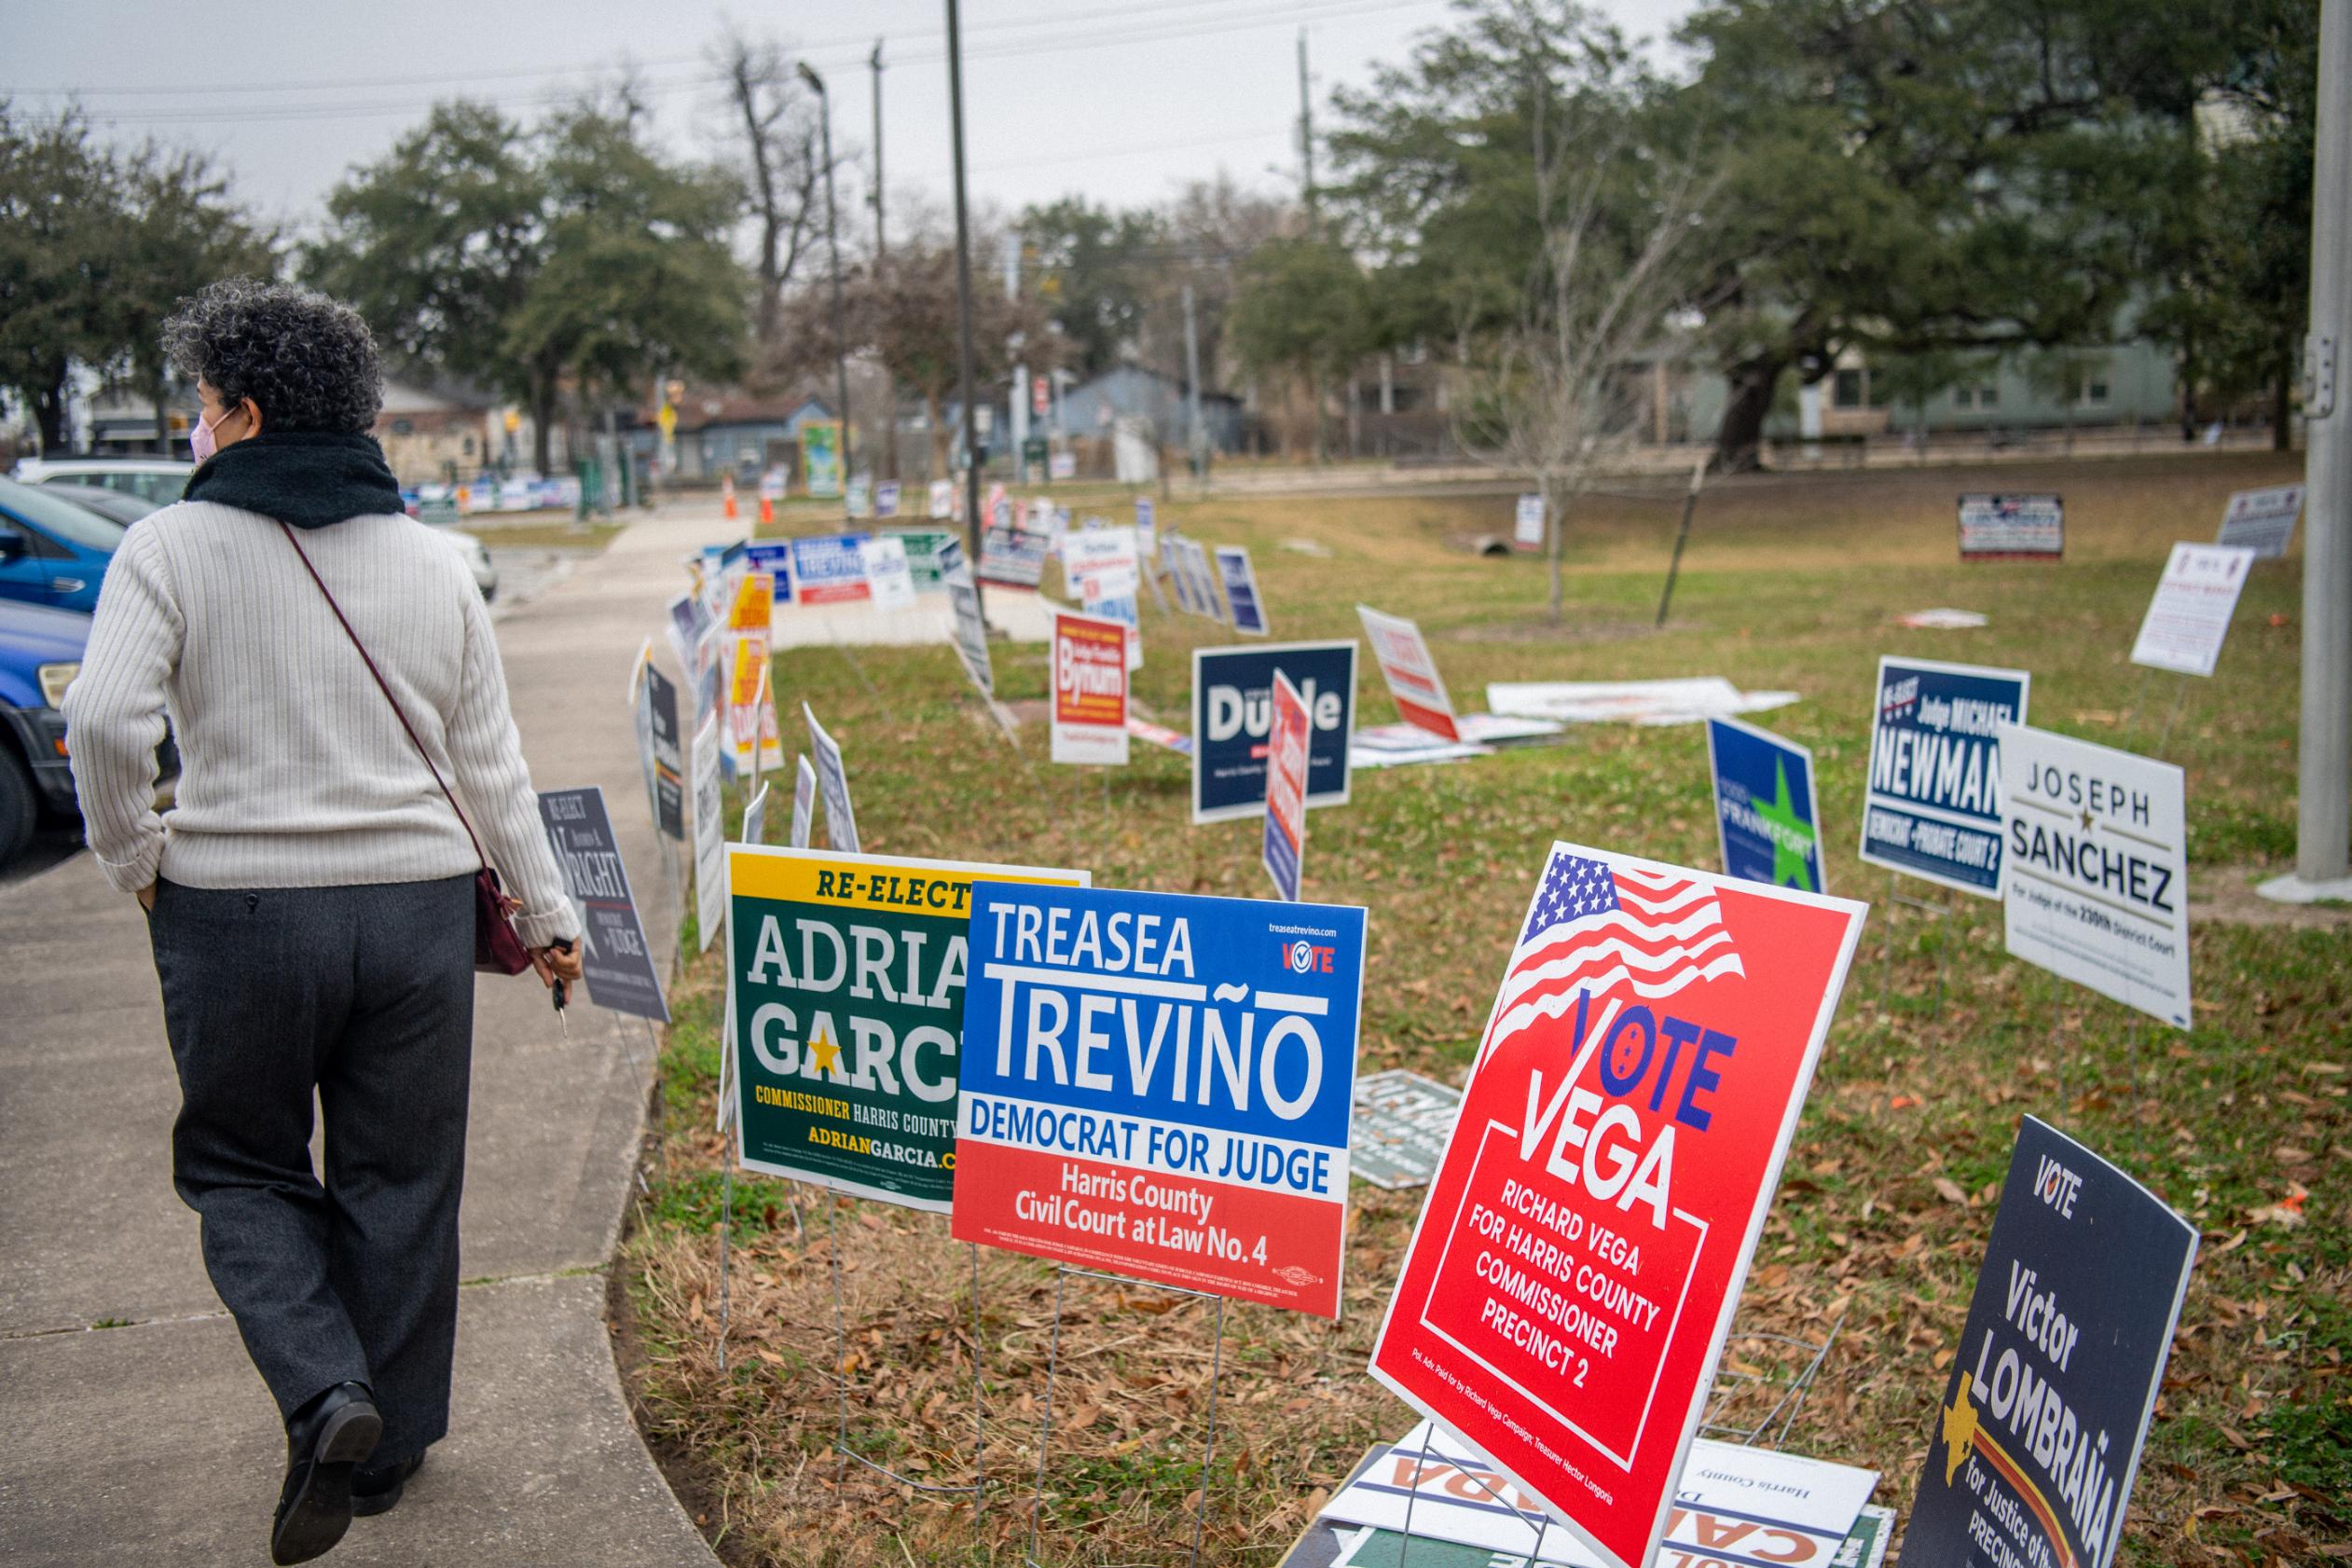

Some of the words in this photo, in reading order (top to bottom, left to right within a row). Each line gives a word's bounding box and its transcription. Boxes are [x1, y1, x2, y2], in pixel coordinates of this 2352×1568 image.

[1059, 636, 1122, 706] Bynum
[1207, 679, 1342, 741] Dule
[1874, 724, 2003, 817] NEWMAN
[2027, 763, 2150, 828] JOSEPH
[548, 826, 626, 898] WRIGHT
[1722, 797, 1813, 862] FRANKFORT
[1987, 838, 2000, 872] 2
[2011, 818, 2174, 914] SANCHEZ
[817, 870, 972, 910] RE-ELECT
[747, 915, 969, 1010] ADRIA
[988, 902, 1195, 978] TREASEA
[1269, 922, 1337, 938] treaseatrevino.com
[1282, 940, 1335, 974] VOTE
[2113, 921, 2146, 945] District
[2148, 931, 2175, 958] Court
[750, 1002, 964, 1103] GARC
[983, 962, 1329, 1121] TREVIÑO
[1571, 988, 1738, 1133] VOTE
[755, 1084, 850, 1121] COMMISSIONER
[853, 1103, 899, 1131] HARRIS
[902, 1113, 958, 1139] COUNTY
[808, 1126, 956, 1170] ADRIANGARCIA.C
[970, 1098, 1139, 1161] DEMOCRAT
[1148, 1126, 1210, 1174] FOR
[1218, 1138, 1330, 1194] JUDGE
[1520, 997, 1675, 1231] VEGA
[1062, 1162, 1126, 1202] Harris
[1130, 1176, 1213, 1225] County
[2033, 1154, 2083, 1220] VOTE
[1015, 1190, 1061, 1226] Civil
[1064, 1201, 1125, 1239] Court
[1133, 1217, 1155, 1242] at
[1158, 1217, 1204, 1254] Law
[1207, 1226, 1248, 1264] No.
[1251, 1234, 1268, 1267] 4
[1501, 1178, 1583, 1241] RICHARD
[1589, 1223, 1641, 1275] VEGA
[1469, 1204, 1504, 1243] FOR
[1506, 1226, 1575, 1283] HARRIS
[1576, 1265, 1661, 1332] COUNTY
[1476, 1251, 1618, 1358] COMMISSIONER
[1480, 1297, 1575, 1376] PRECINCT
[1574, 1358, 1590, 1389] 2
[2005, 1259, 2079, 1372] Victor
[1411, 1348, 1423, 1361] Pol.
[1423, 1355, 1435, 1371] Adv.
[1436, 1365, 1449, 1380] Paid
[1447, 1373, 1456, 1385] for
[1455, 1379, 1465, 1393] by
[1464, 1385, 1486, 1409] Richard
[1488, 1404, 1503, 1422] Vega
[1503, 1413, 1534, 1446] Campaign;
[1534, 1437, 1562, 1466] Treasurer
[1562, 1458, 1585, 1483] Hector
[1585, 1477, 1614, 1506] Longoria
[1971, 1327, 2114, 1568] LOMBRAÑA
[1695, 1469, 1754, 1489] County
[1757, 1479, 1811, 1500] Harris
[1965, 1455, 1987, 1495] for
[1984, 1479, 2029, 1548] Justice
[2029, 1534, 2043, 1566] of
[2039, 1545, 2051, 1568] th
[1968, 1508, 2025, 1568] PRECIN
